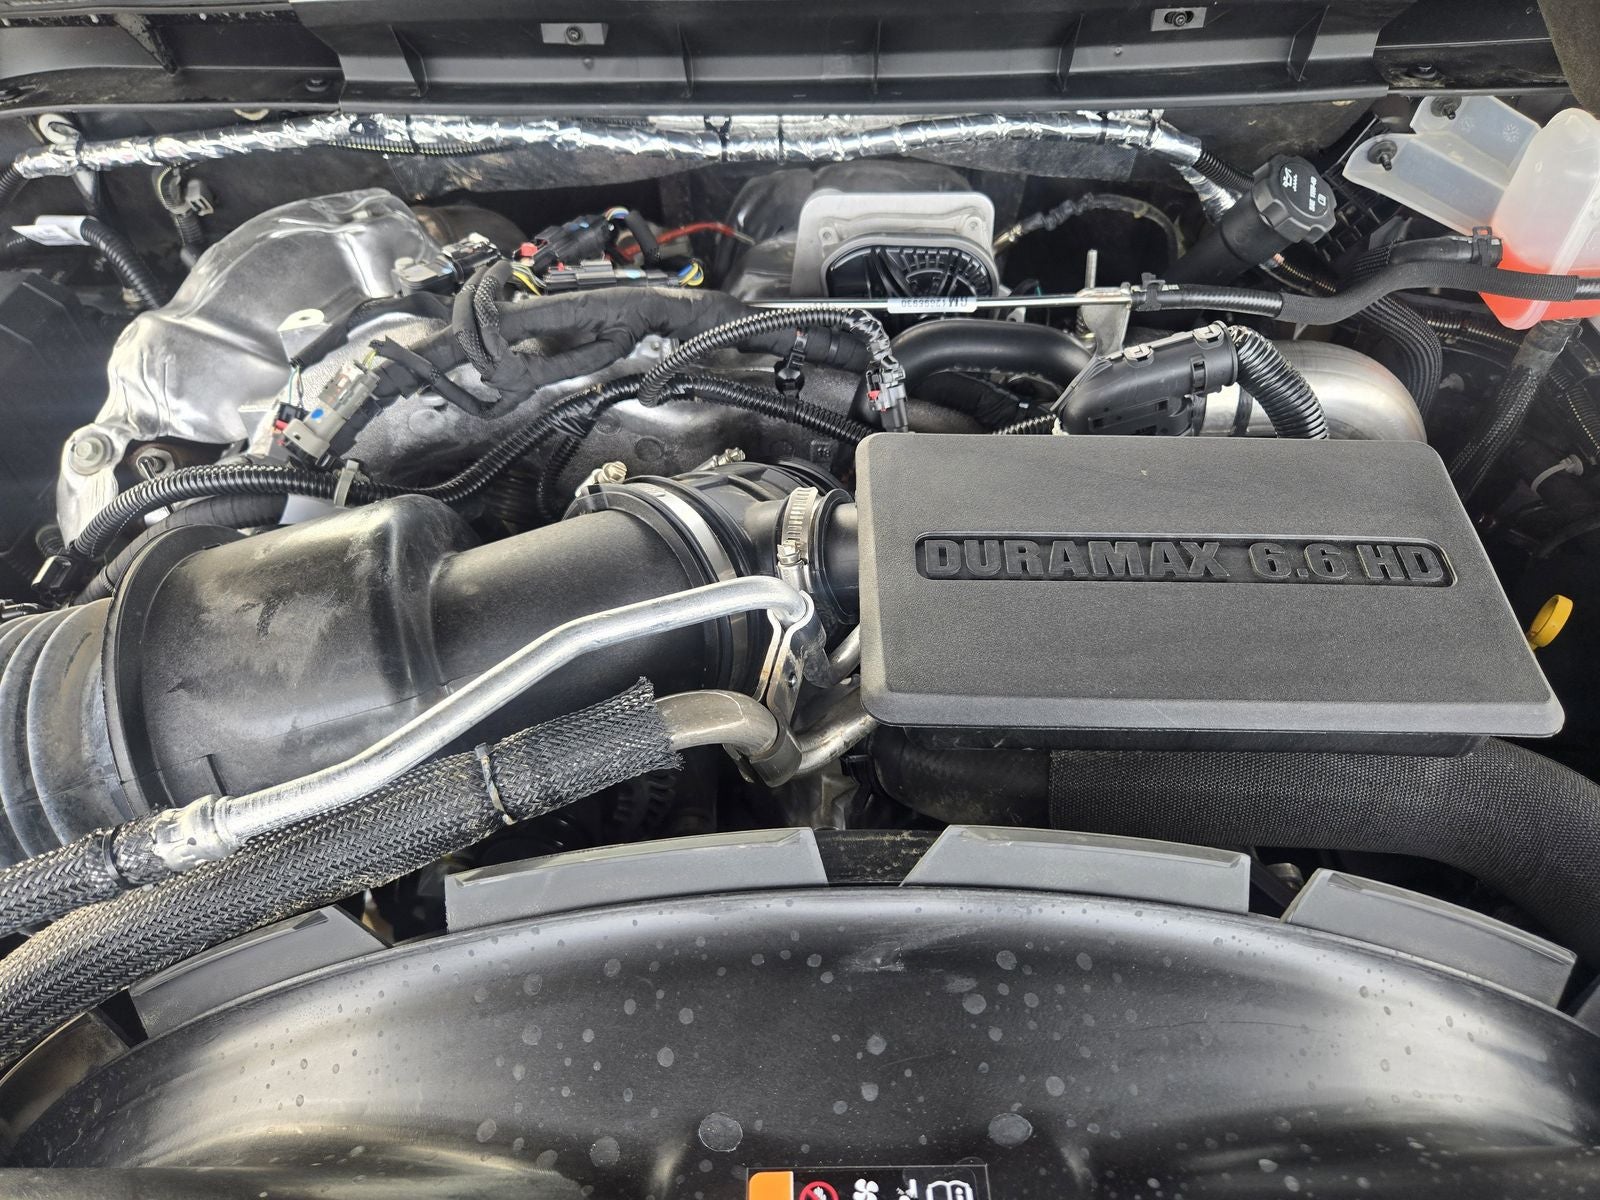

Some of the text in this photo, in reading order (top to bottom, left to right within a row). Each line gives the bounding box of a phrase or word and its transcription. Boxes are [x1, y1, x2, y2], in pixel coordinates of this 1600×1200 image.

[948, 297, 968, 308] GM
[924, 539, 1444, 582] DURAMAX 6.6 HD
